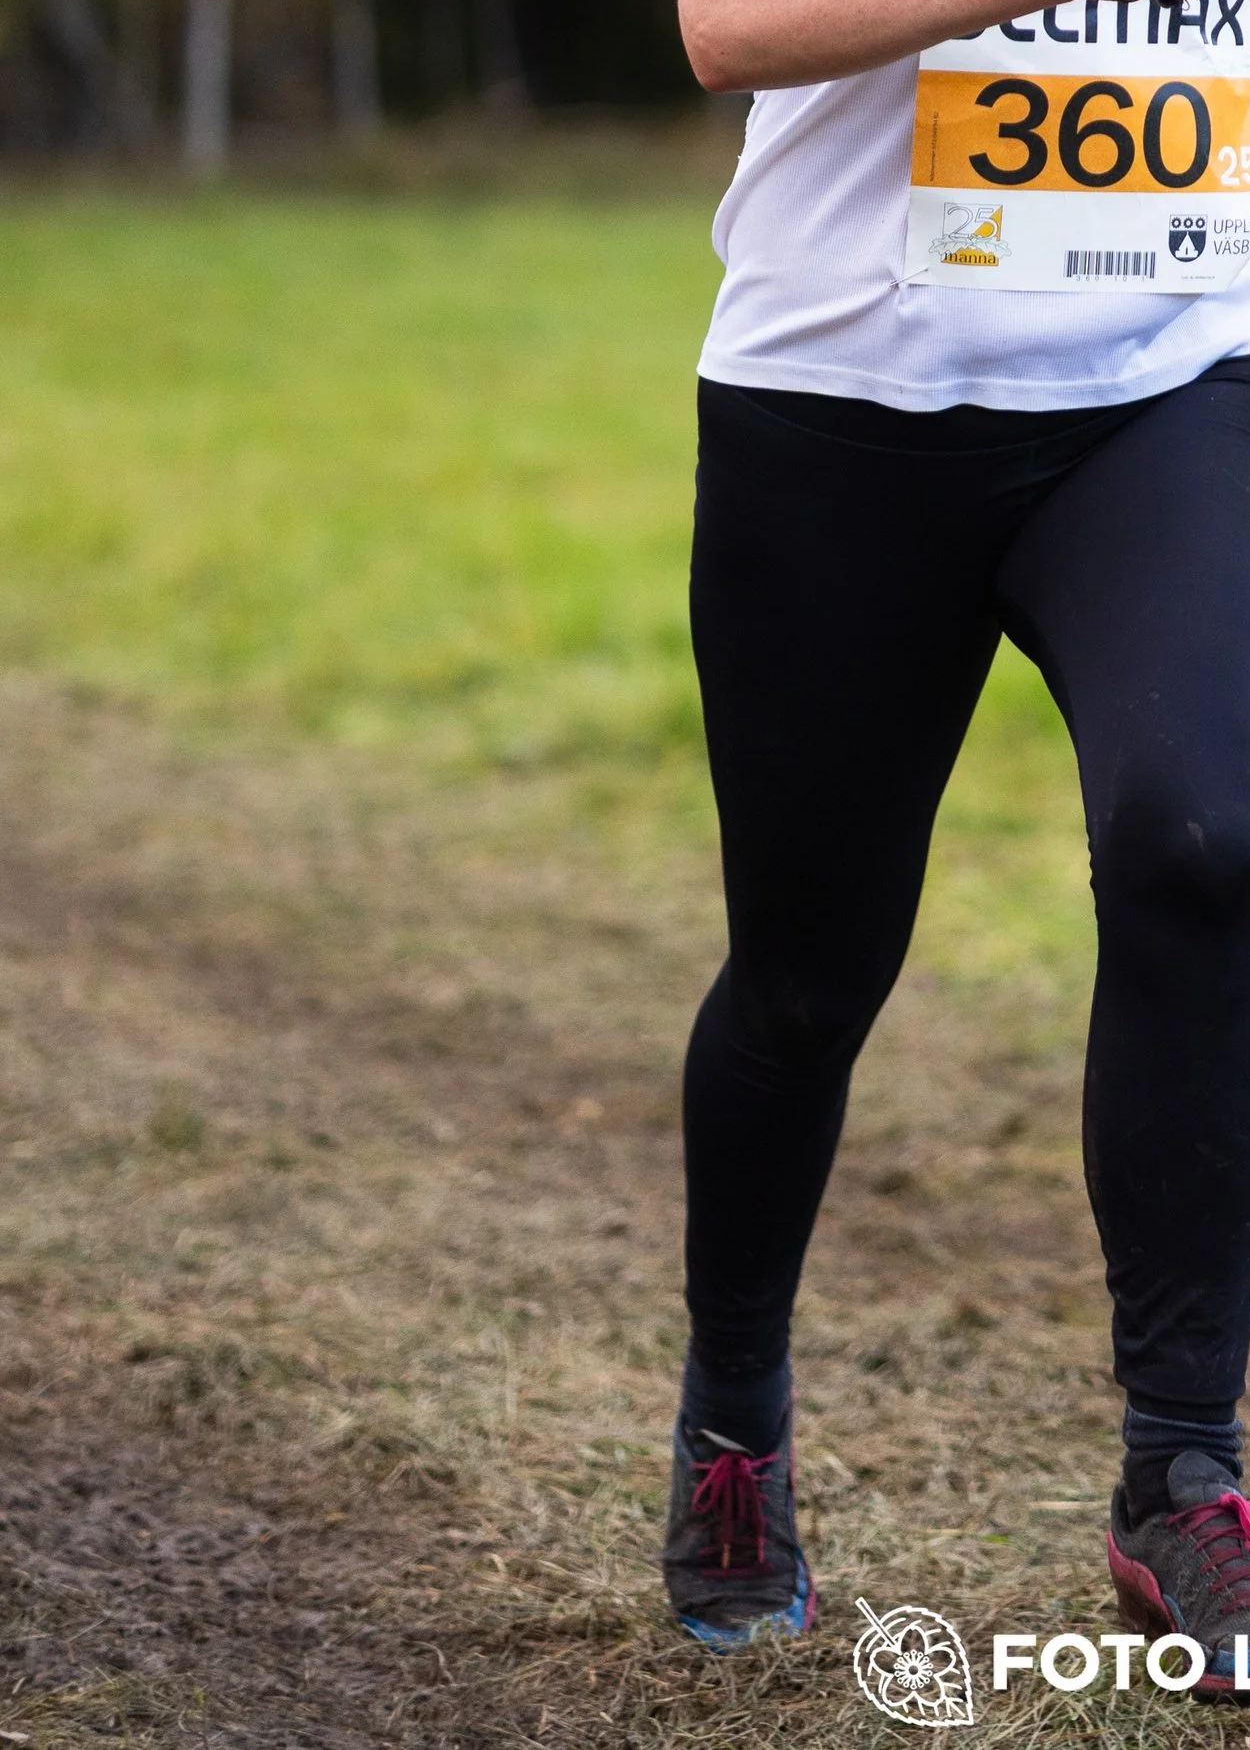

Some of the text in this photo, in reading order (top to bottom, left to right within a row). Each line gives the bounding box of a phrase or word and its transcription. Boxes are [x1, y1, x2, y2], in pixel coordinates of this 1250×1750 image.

[968, 78, 1212, 189] 360
[947, 206, 999, 241] 25
[942, 251, 997, 265] manna
